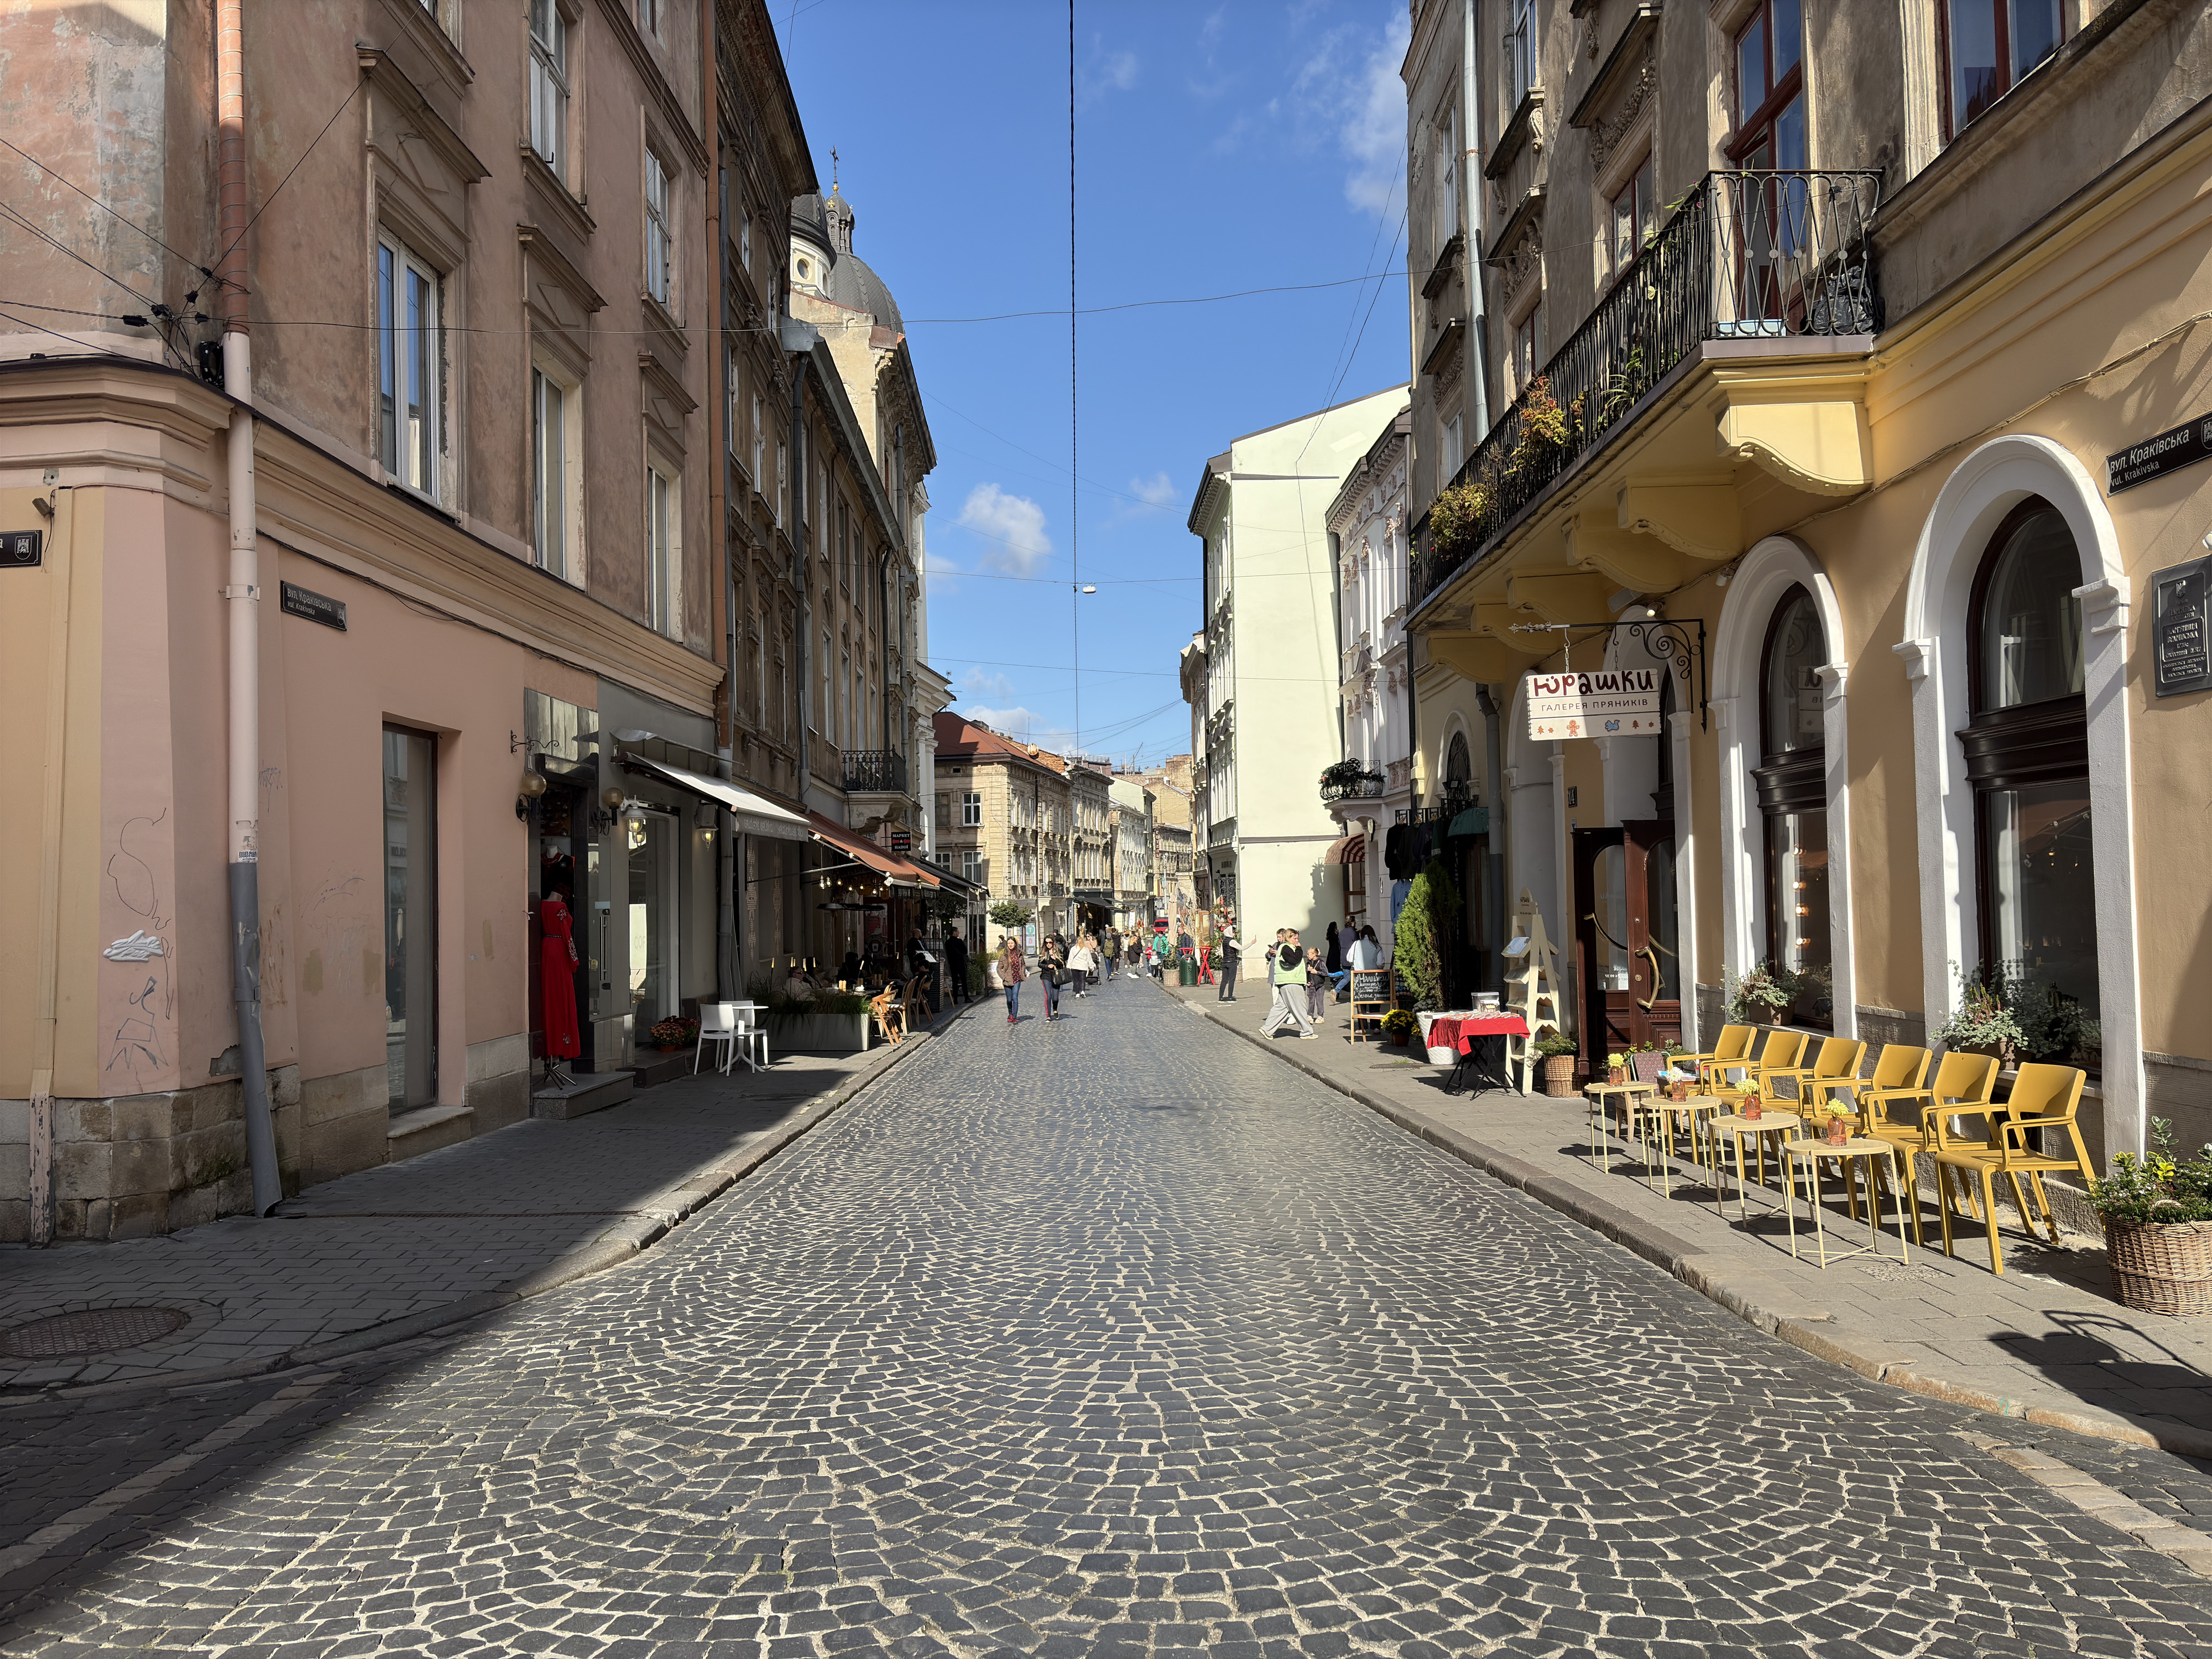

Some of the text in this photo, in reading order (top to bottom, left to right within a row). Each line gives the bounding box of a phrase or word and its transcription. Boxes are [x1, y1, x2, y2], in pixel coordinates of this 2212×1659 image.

[2110, 429, 2189, 473] вул. Краківська
[2111, 461, 2159, 487] vul. Krakivska
[296, 603, 315, 615] Krakivska
[299, 591, 332, 612] Краківська
[1542, 699, 1648, 712] ГАЛЕРЕЯ ПРЯНИКІВ
[1569, 789, 1575, 805] 14
